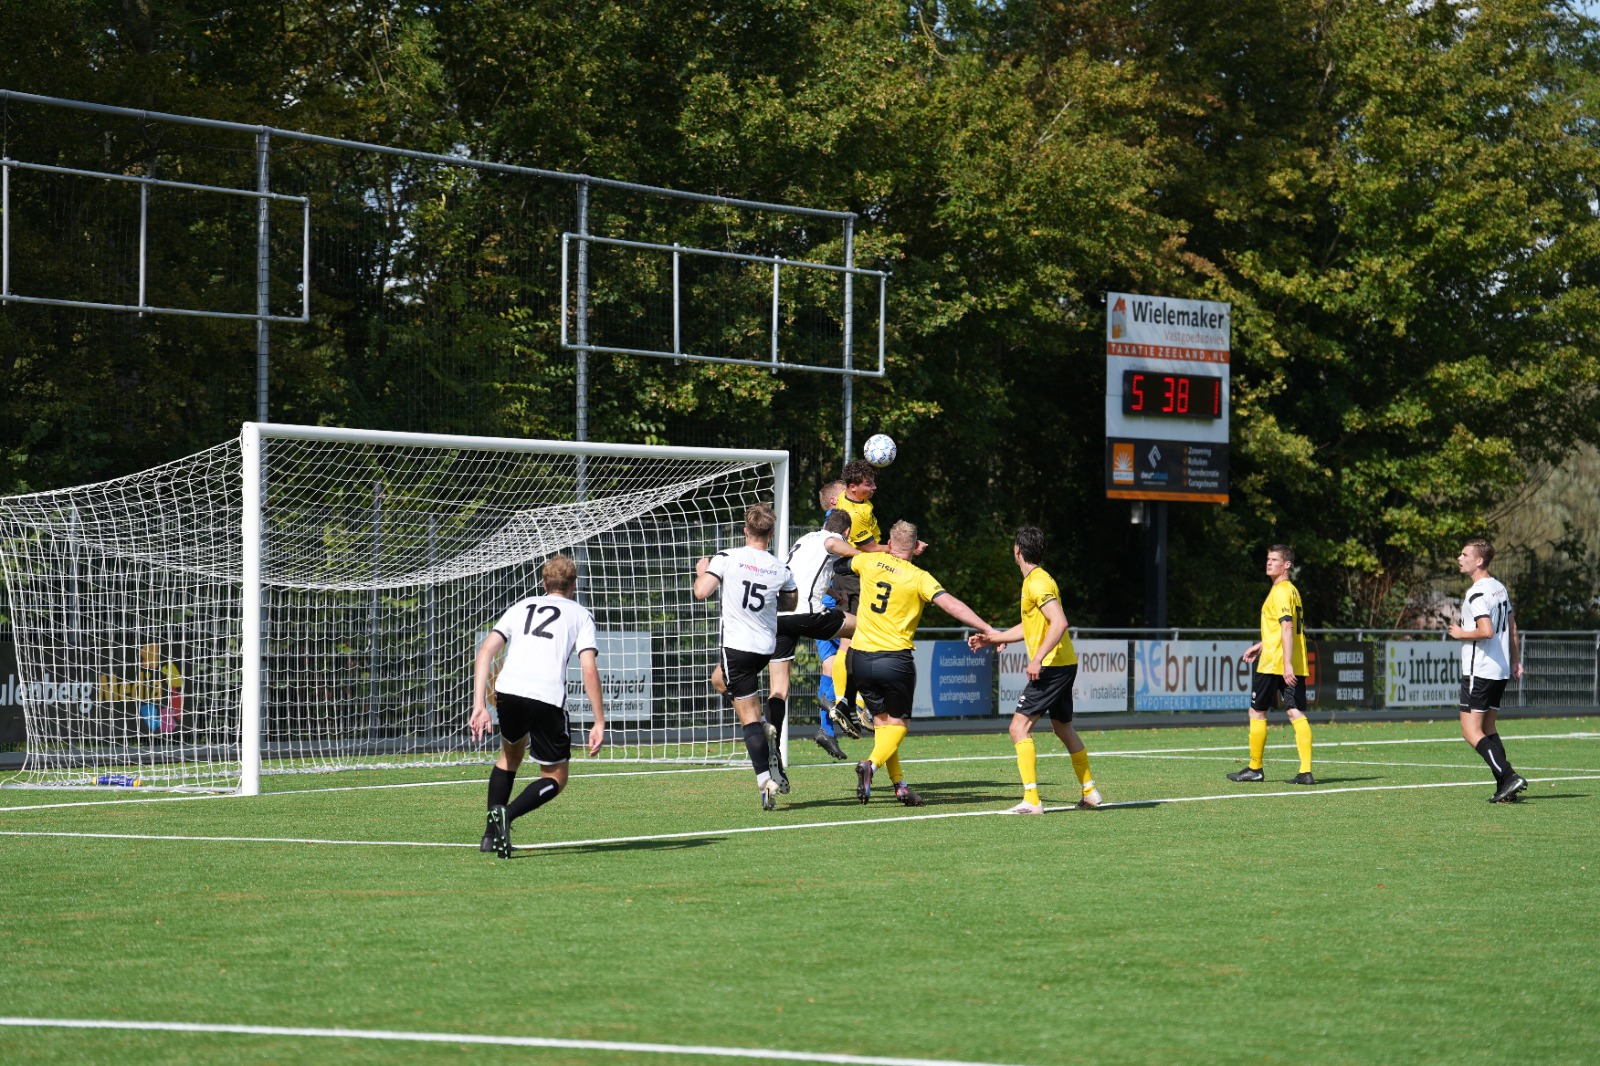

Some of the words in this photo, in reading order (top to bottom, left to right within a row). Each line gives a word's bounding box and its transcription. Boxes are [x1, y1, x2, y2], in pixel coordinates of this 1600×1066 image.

[1132, 301, 1224, 329] Wielemaker
[1164, 330, 1225, 345] Vastgoedadvies
[1131, 375, 1144, 410] 5
[1162, 377, 1189, 413] 38
[742, 580, 767, 612] 15
[871, 581, 892, 614] 3
[523, 603, 561, 640] 12
[939, 656, 965, 667] klassikaal
[966, 656, 985, 666] theorie
[1082, 652, 1127, 673] ROTIKO
[100, 671, 162, 701] Media
[939, 674, 976, 687] personenauto
[939, 690, 981, 704] aanhangwagen
[1090, 685, 1127, 700] installatie
[1409, 690, 1419, 701] HET
[1423, 690, 1446, 701] GROENE
[1136, 697, 1191, 710] HYPOTHEKEN
